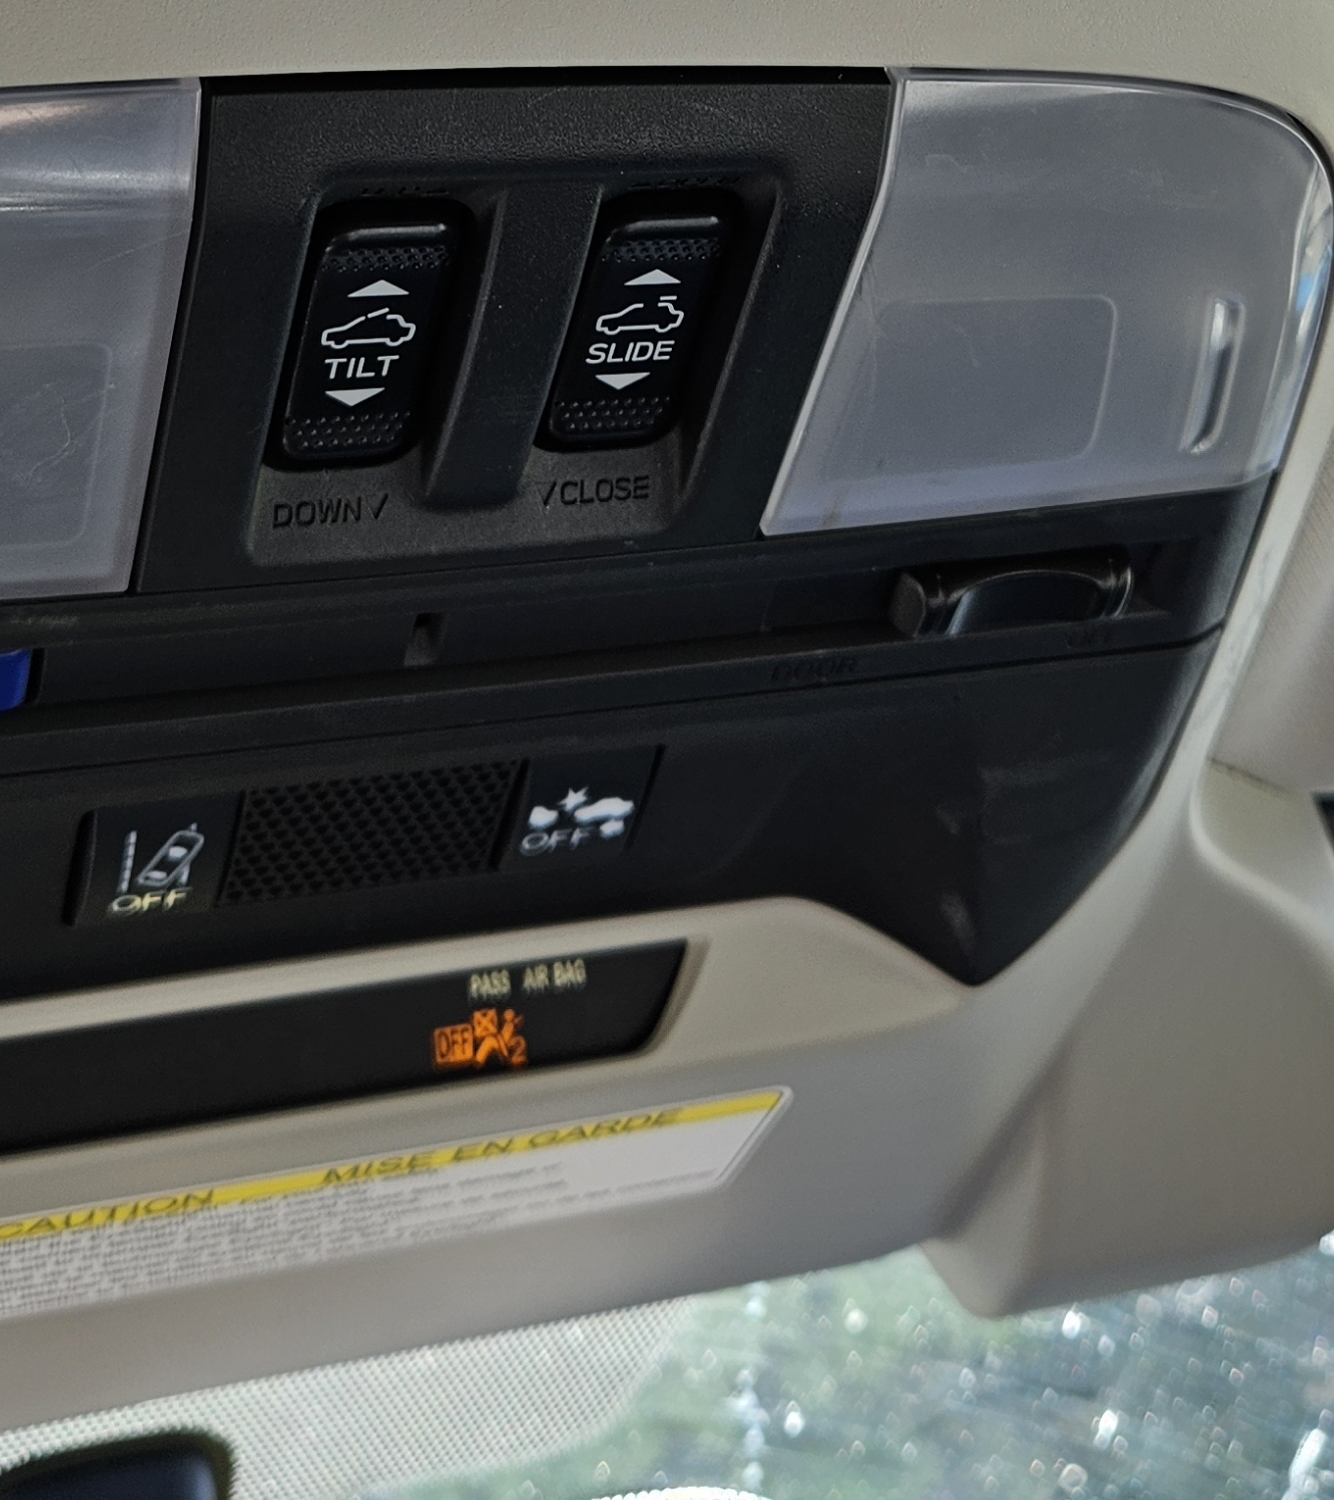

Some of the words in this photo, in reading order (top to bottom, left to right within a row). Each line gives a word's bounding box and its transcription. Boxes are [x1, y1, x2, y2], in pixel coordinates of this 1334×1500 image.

[324, 354, 400, 380] TILT
[585, 339, 675, 365] SLIDE
[559, 474, 651, 506] CLOSE
[272, 499, 363, 529] DOWN
[520, 826, 591, 856] OFF
[110, 887, 191, 913] OFF
[469, 968, 511, 1000] PASS
[523, 962, 549, 992] AIR
[553, 957, 587, 990] BAG
[437, 1029, 470, 1059] OFF
[322, 1151, 434, 1186] MISE
[450, 1136, 515, 1163] EN
[528, 1107, 685, 1150] GARDE
